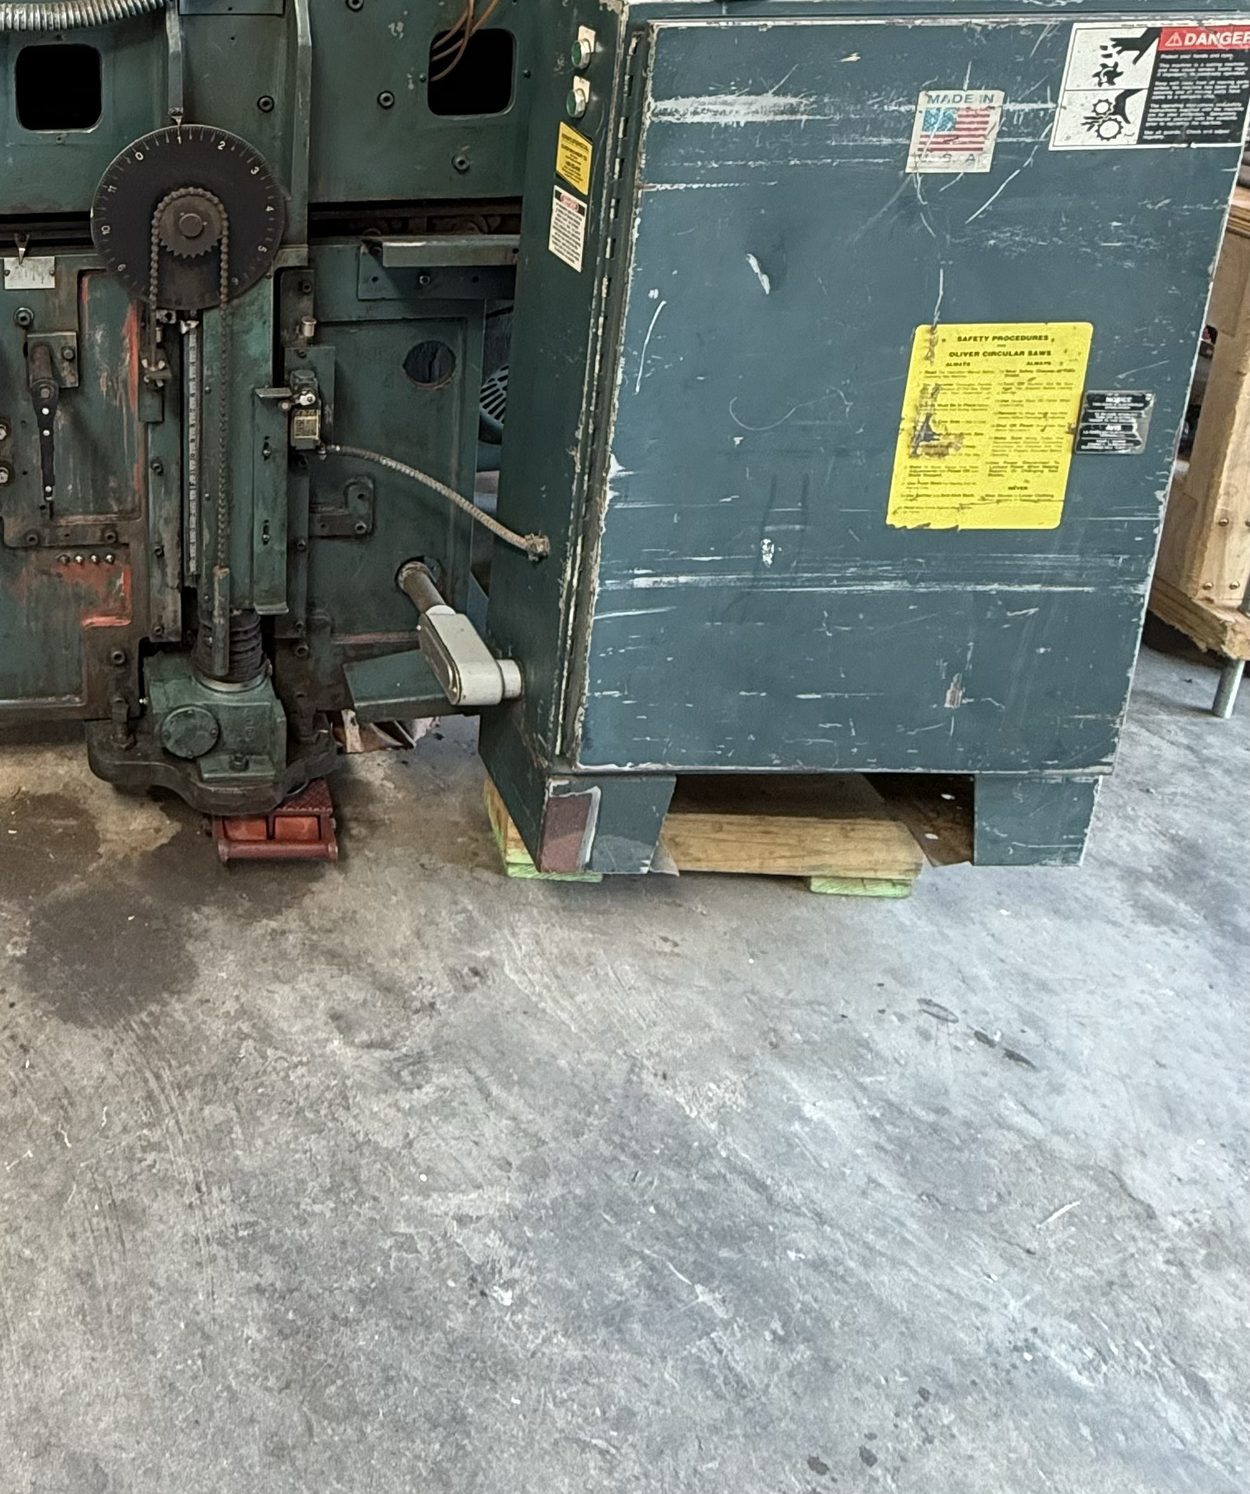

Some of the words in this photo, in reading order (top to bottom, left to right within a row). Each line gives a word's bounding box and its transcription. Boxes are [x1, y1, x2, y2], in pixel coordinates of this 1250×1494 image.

[926, 94, 973, 104] MADE
[979, 94, 994, 104] IN
[217, 140, 226, 151] 2
[135, 151, 144, 161] 0
[249, 166, 260, 175] 3
[265, 205, 275, 213] 4
[257, 245, 268, 254] 5
[991, 334, 1049, 342] PROCEDURES
[948, 350, 980, 358] OLIVER
